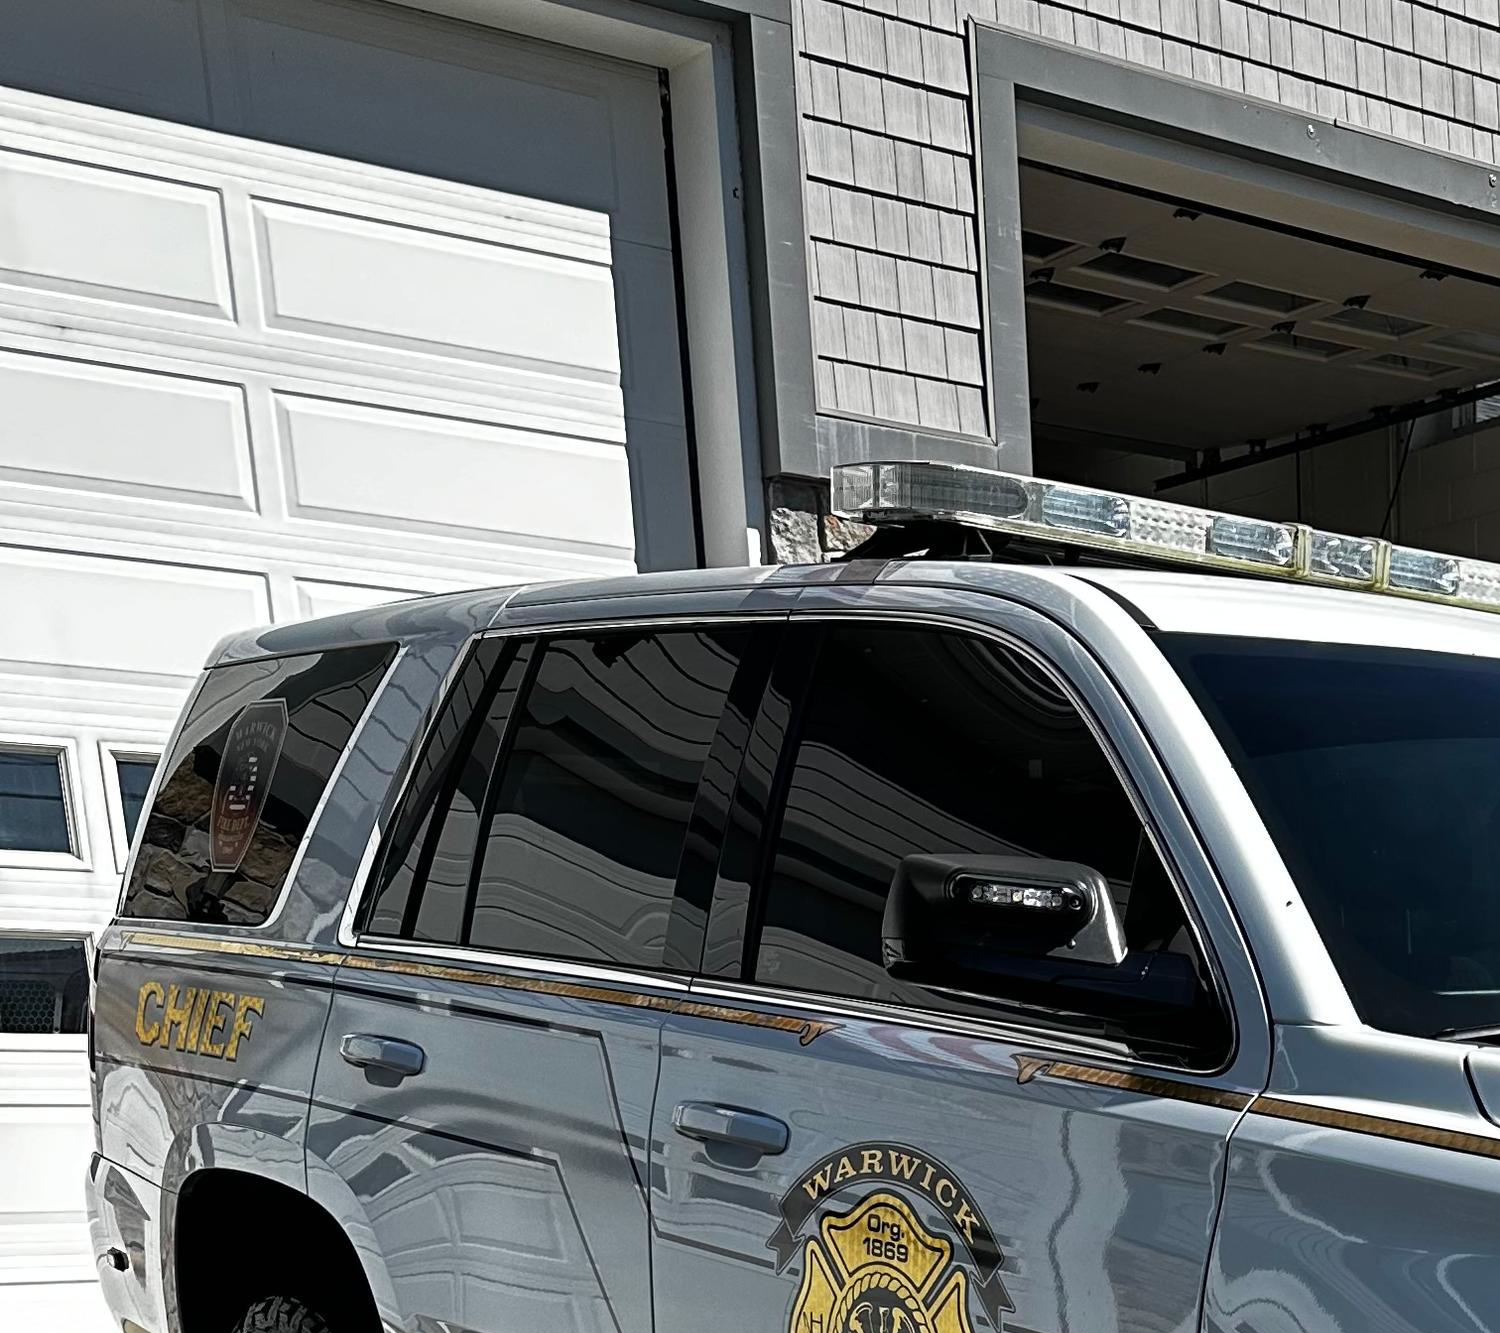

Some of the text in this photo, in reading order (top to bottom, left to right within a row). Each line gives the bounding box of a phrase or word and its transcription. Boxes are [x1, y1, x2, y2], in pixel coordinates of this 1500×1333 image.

[136, 982, 265, 1062] CHIEF
[802, 1149, 981, 1245] WARWICK
[863, 1237, 909, 1263] 1869
[867, 1213, 905, 1241] Org.
